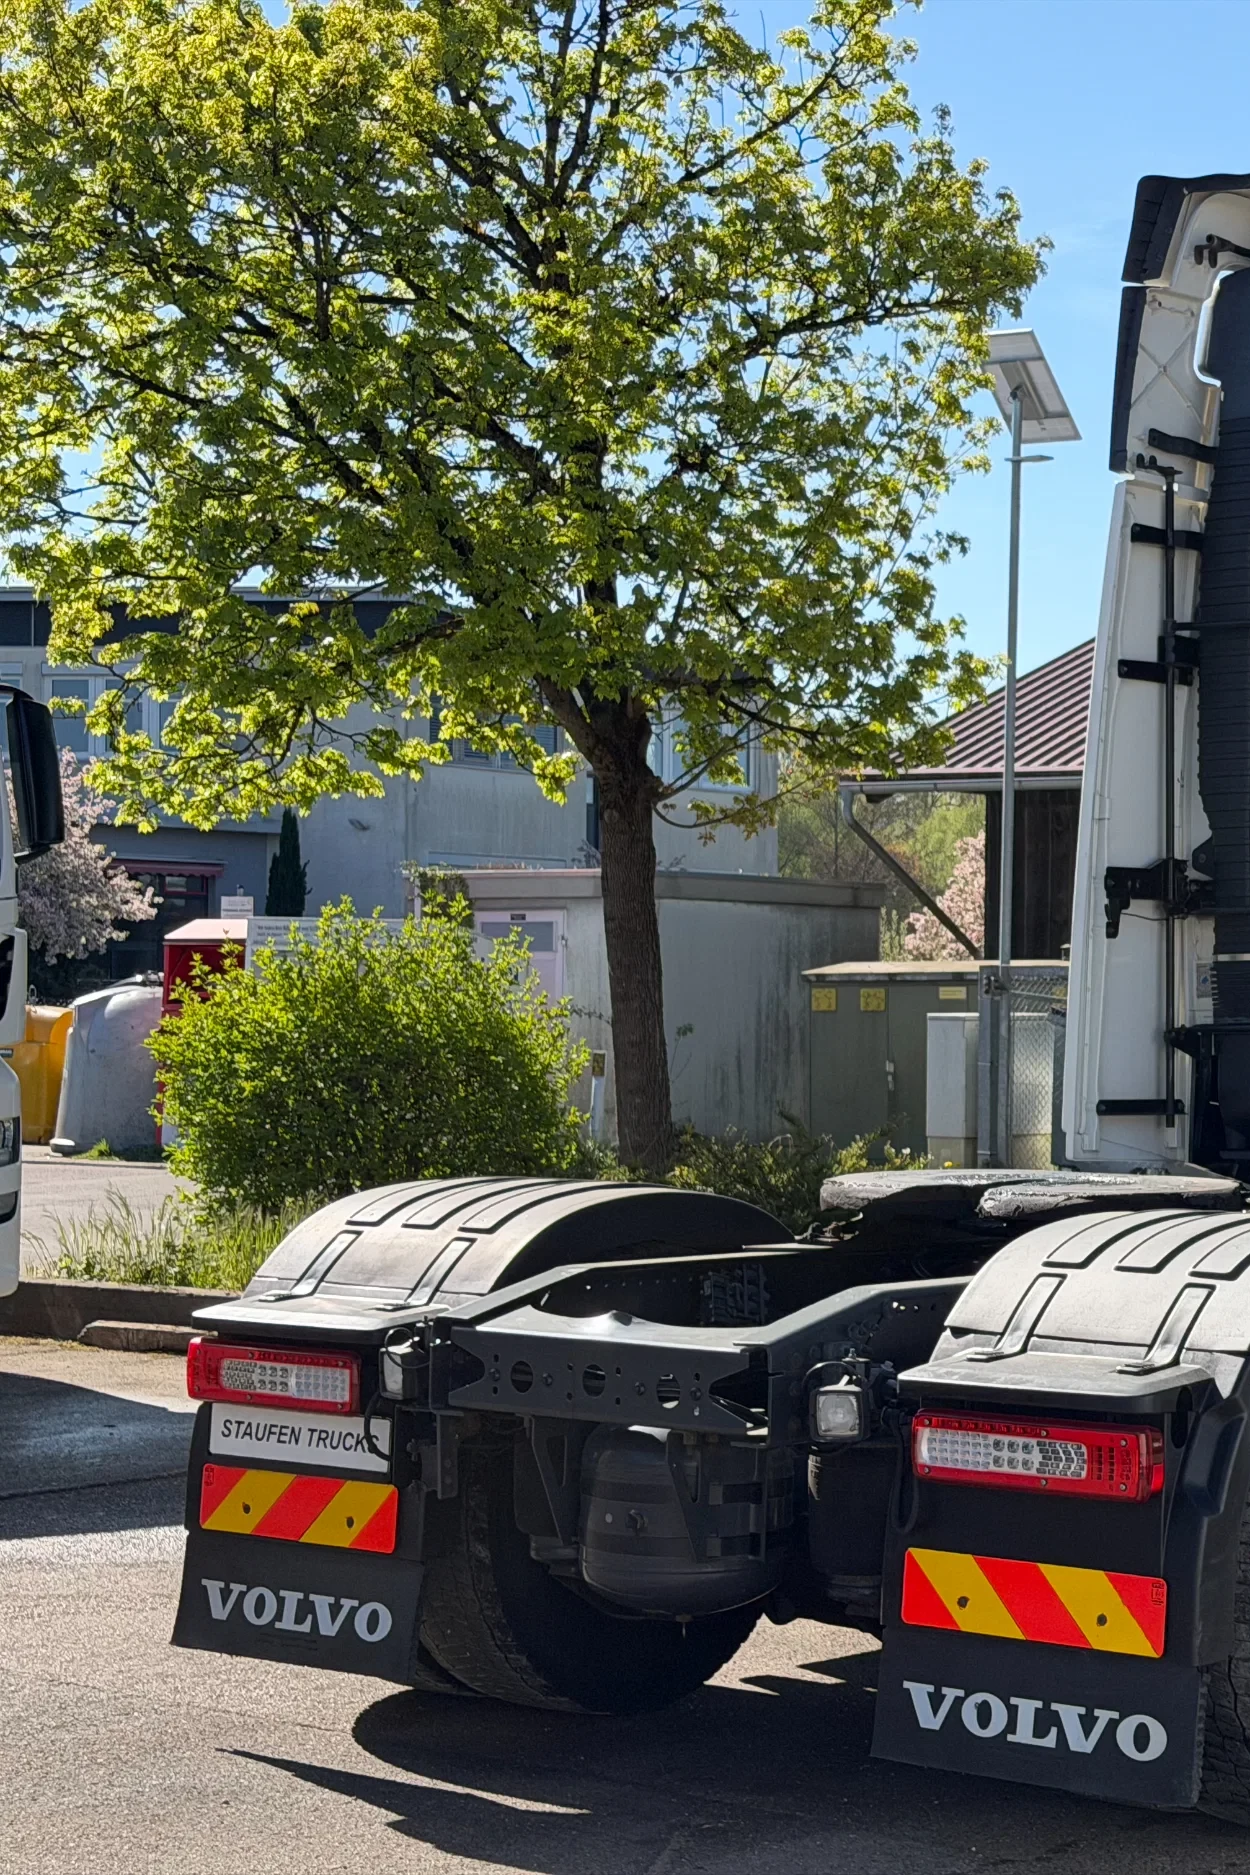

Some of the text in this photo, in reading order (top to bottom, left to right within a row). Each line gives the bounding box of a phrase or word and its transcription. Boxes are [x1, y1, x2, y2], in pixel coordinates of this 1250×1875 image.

[221, 1419, 380, 1454] STAUFEN TRUCKS
[201, 1578, 393, 1643] VOLVO
[903, 1680, 1168, 1762] VOLVO
